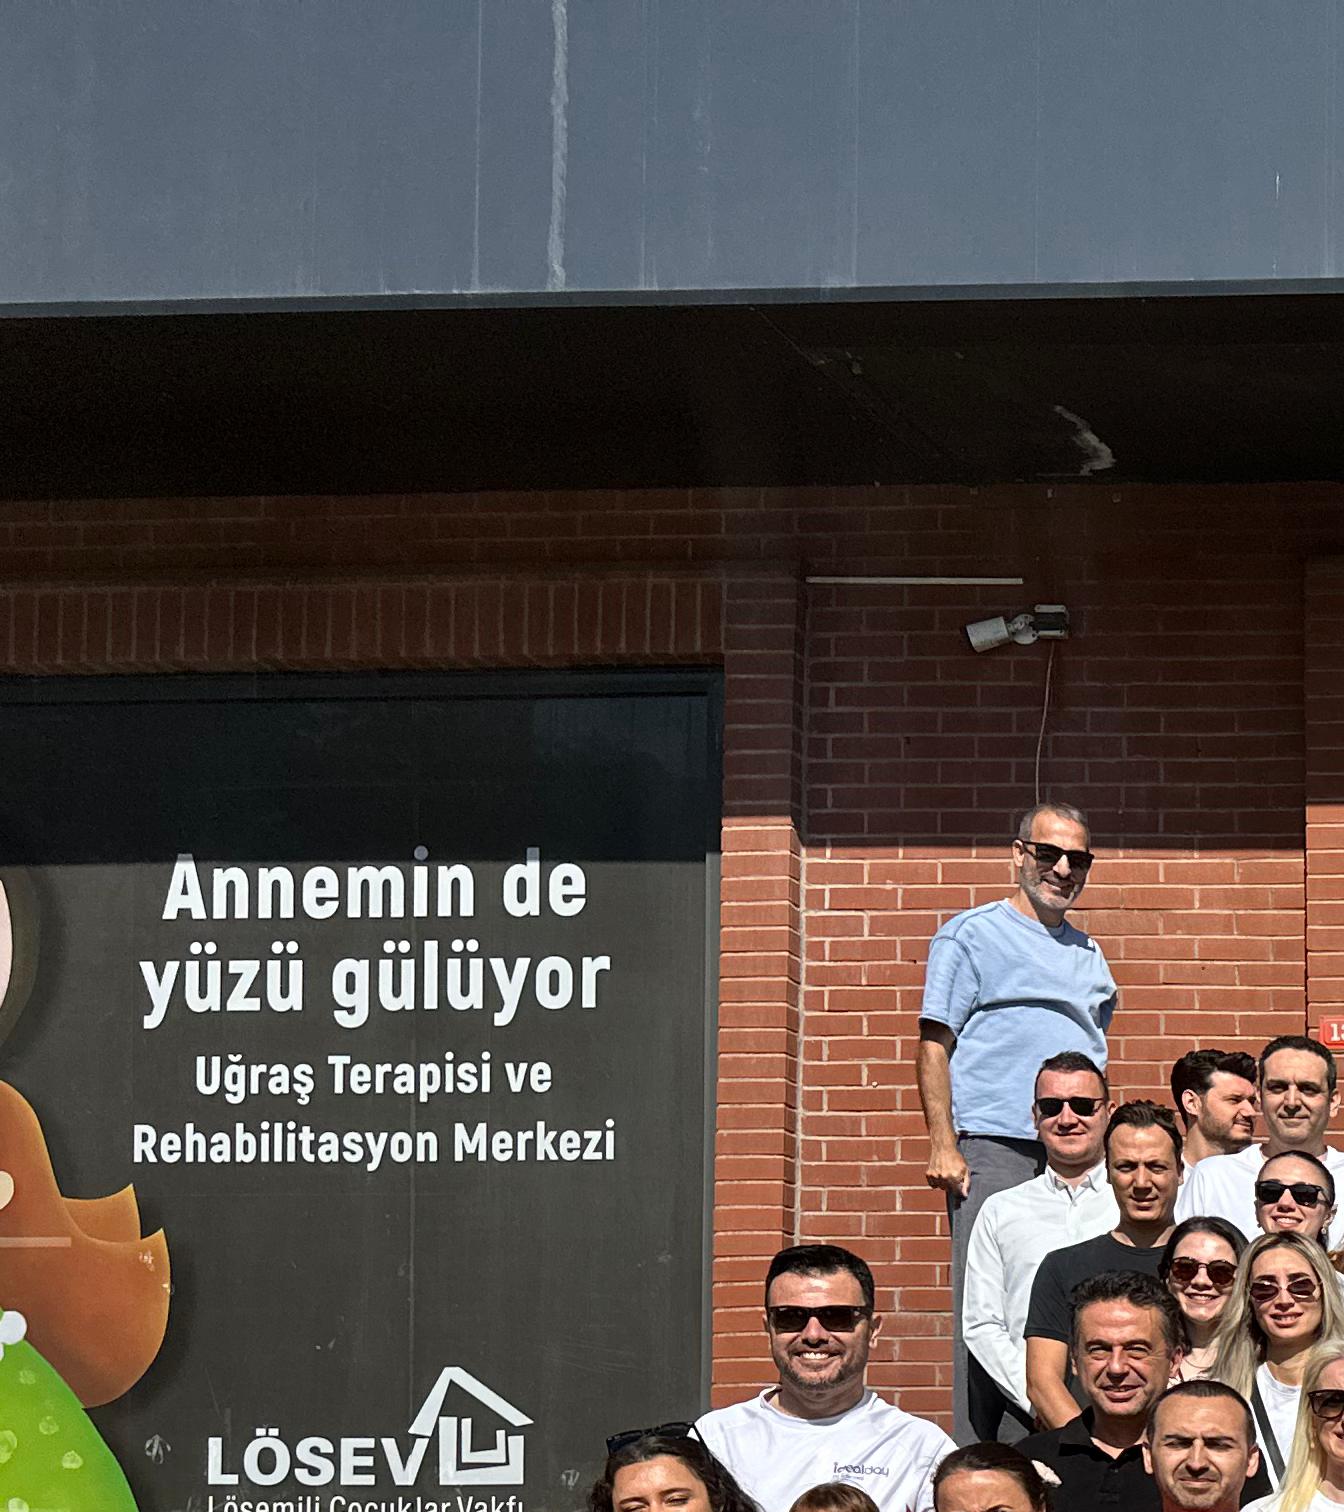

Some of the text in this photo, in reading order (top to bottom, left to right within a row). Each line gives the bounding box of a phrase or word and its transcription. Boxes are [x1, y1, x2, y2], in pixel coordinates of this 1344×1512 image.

[162, 847, 589, 921] Annemin de
[138, 940, 611, 1030] yüzü gülüyor
[195, 1051, 553, 1106] Uğraş Terapisi ve
[133, 1118, 617, 1172] Rehabilitasyon Merkezi
